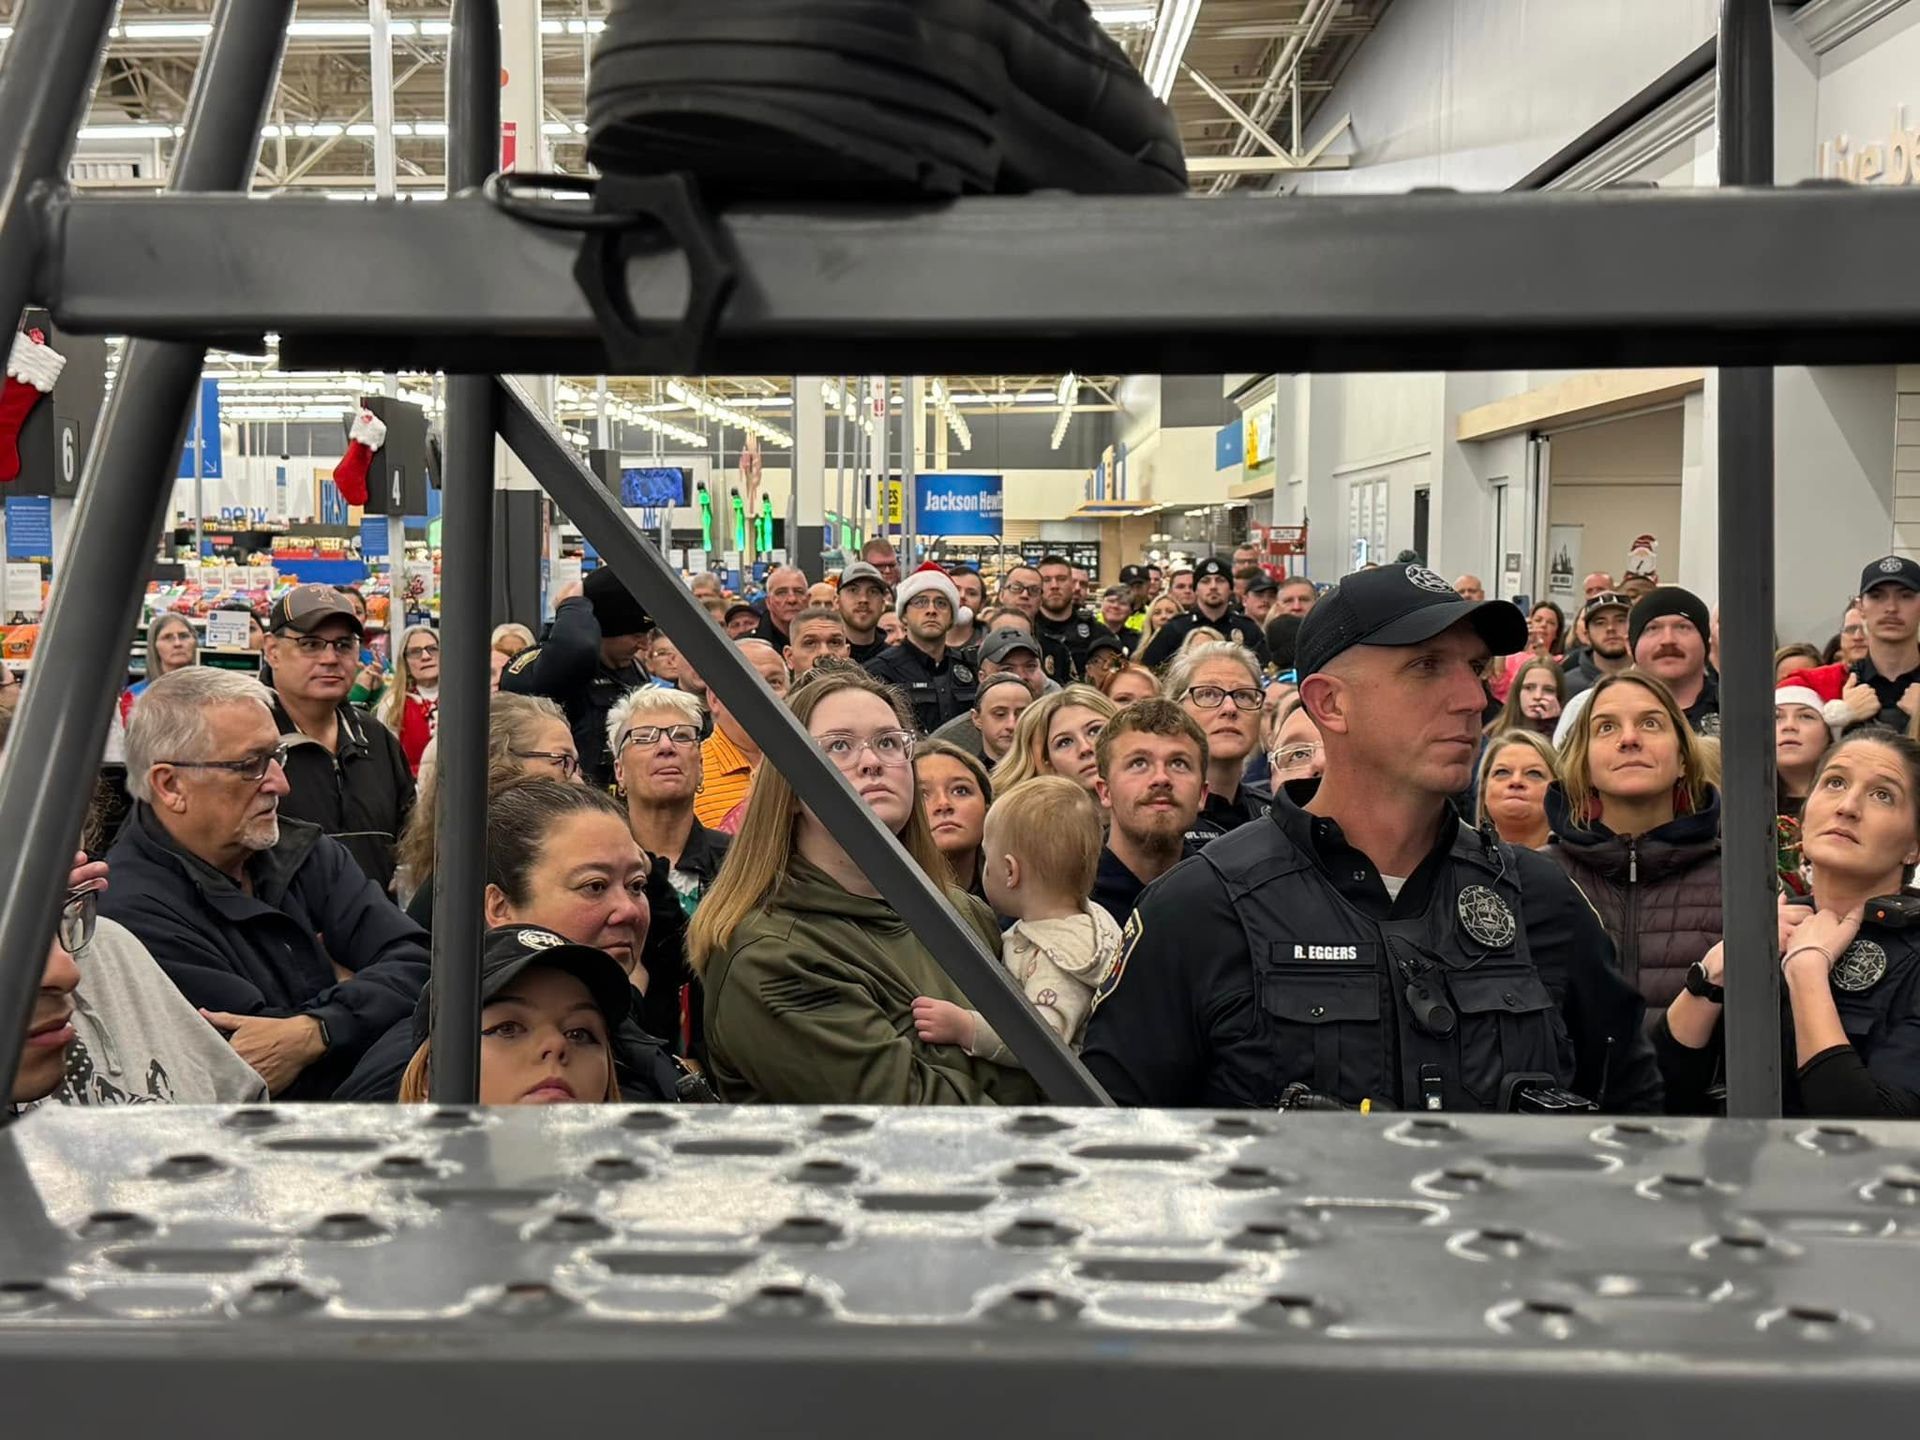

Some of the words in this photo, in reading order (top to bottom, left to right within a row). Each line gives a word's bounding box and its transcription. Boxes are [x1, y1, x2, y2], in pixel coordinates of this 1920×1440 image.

[62, 426, 74, 482] 6
[392, 470, 401, 506] 4
[925, 489, 978, 511] Jackson
[1294, 944, 1307, 959] R.
[1308, 945, 1357, 960] EGGERS
